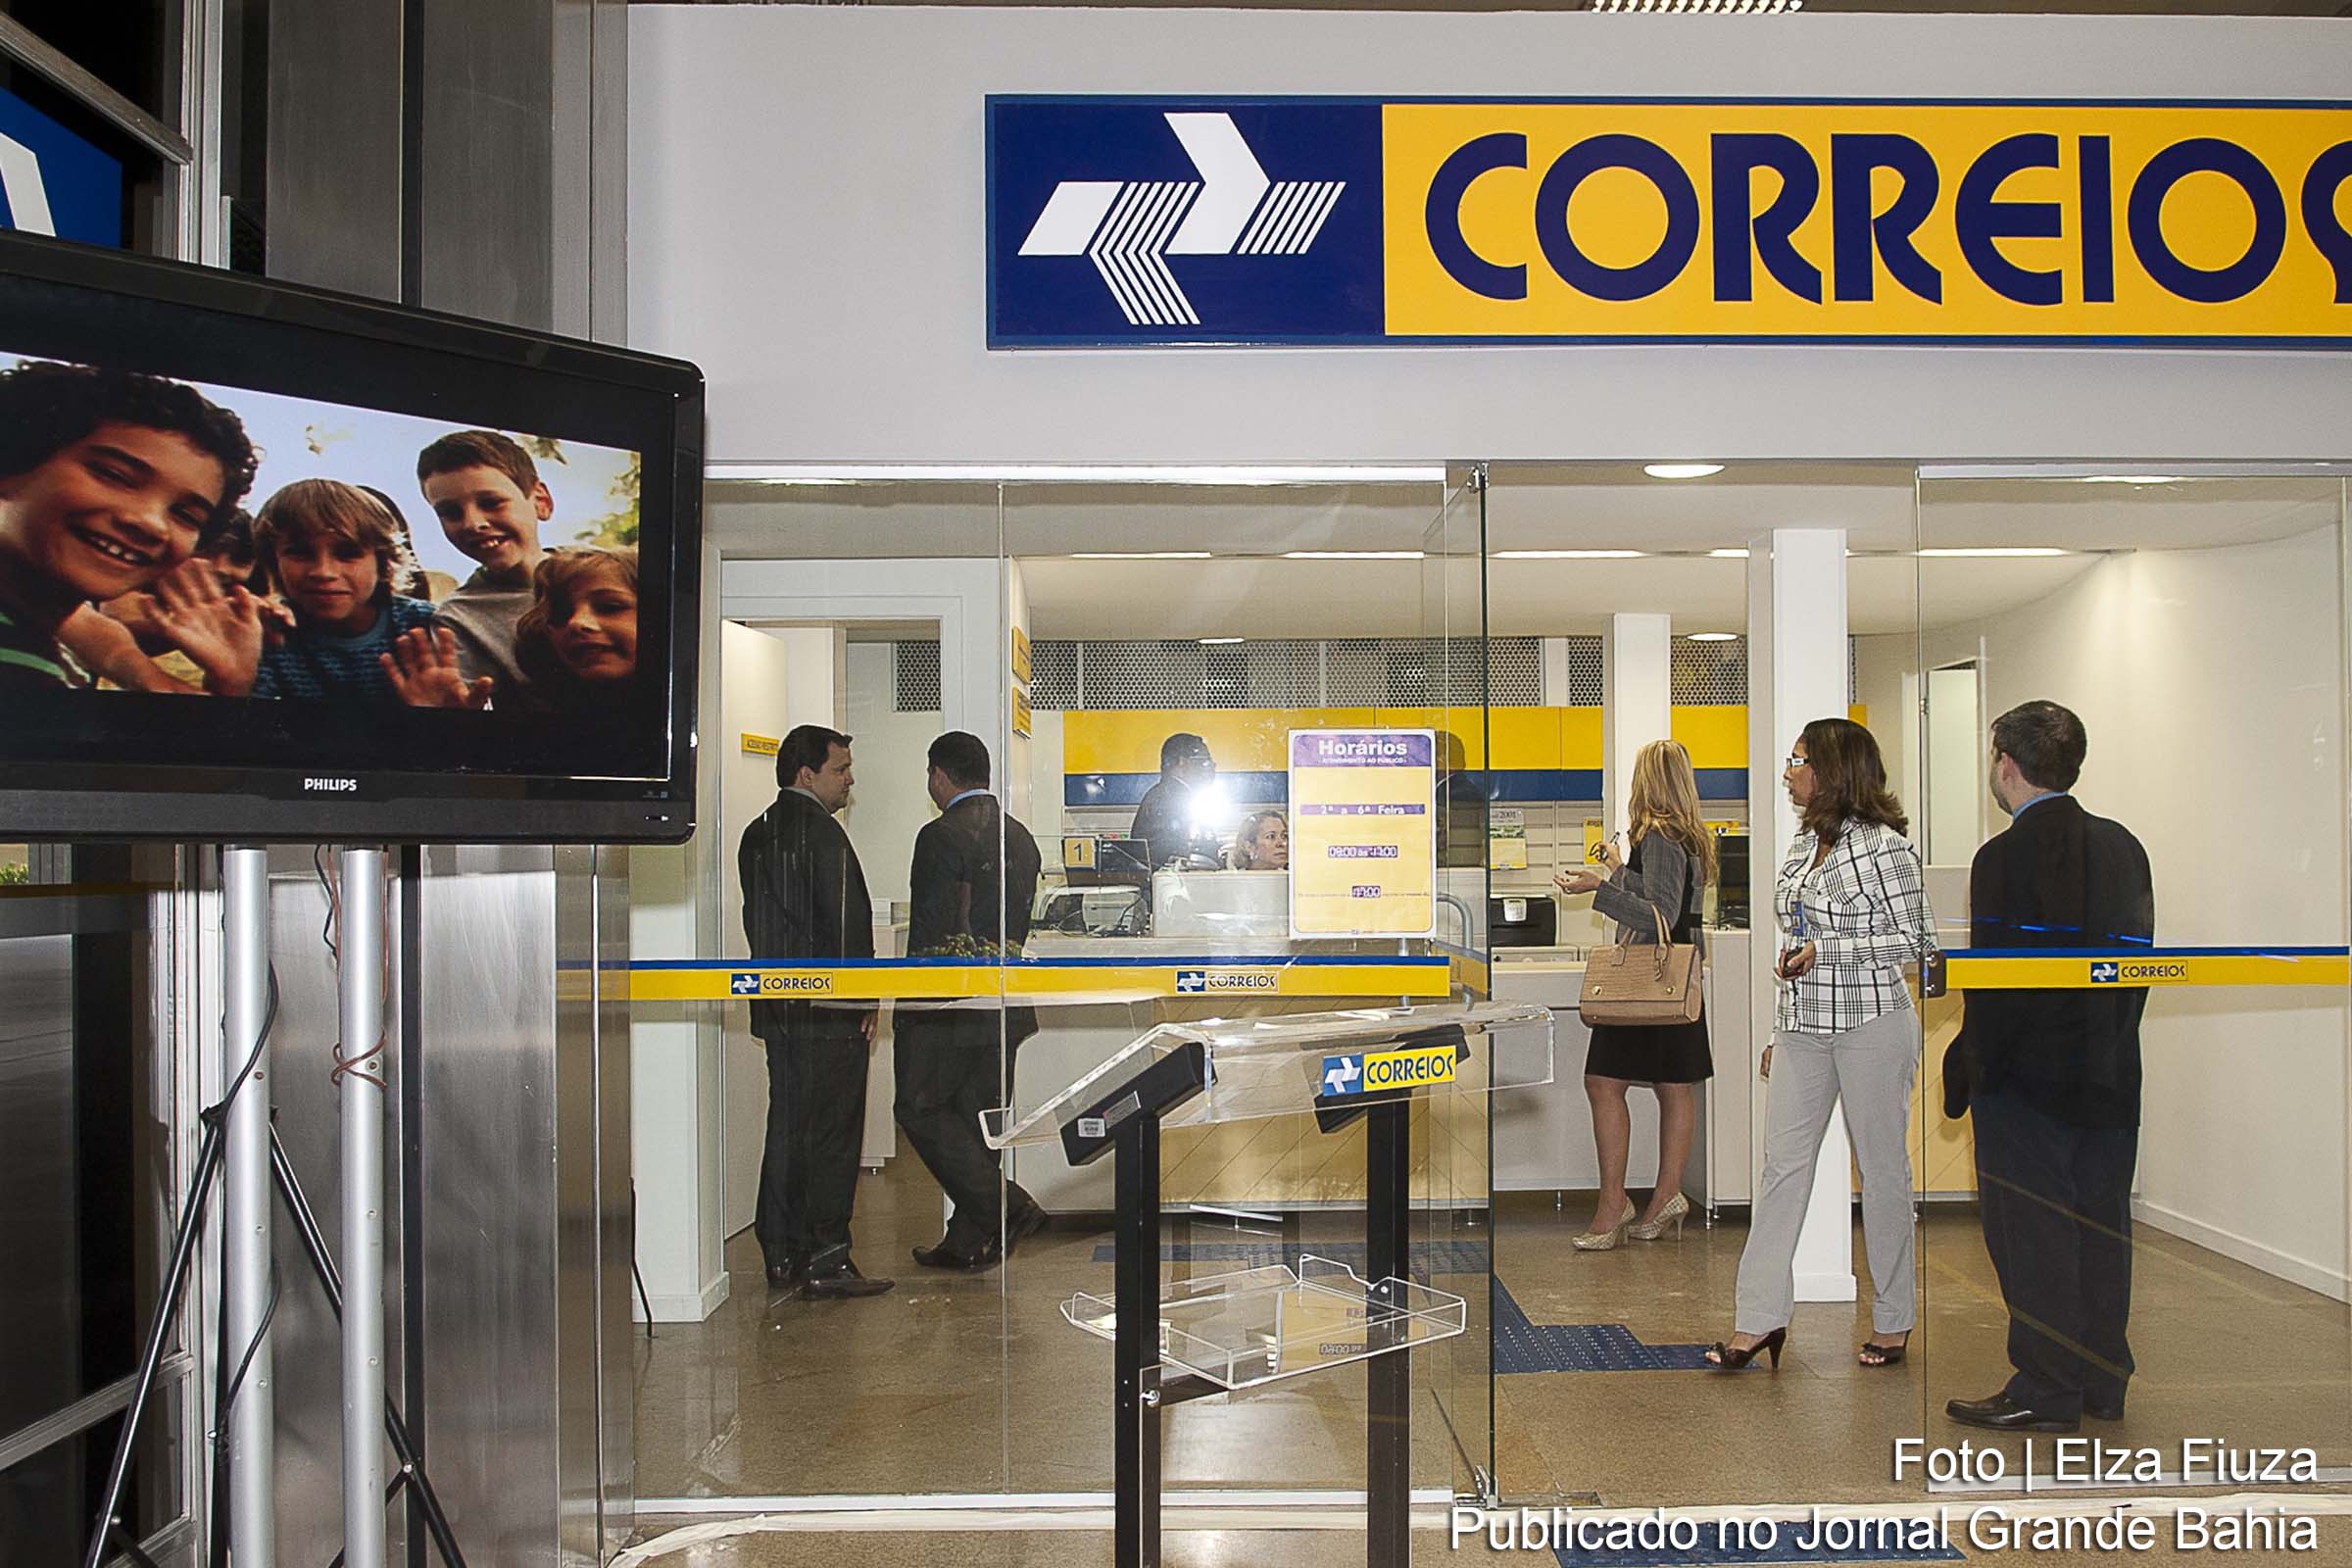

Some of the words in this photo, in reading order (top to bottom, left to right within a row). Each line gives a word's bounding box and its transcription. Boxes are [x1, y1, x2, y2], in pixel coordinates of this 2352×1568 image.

[1426, 131, 2352, 307] CORREIOS
[1318, 739, 1407, 756] Horários
[304, 778, 357, 792] PHILIPS
[1378, 805, 1404, 814] Feira
[1073, 843, 1082, 861] 1
[2121, 965, 2185, 978] CORREIOS
[763, 977, 830, 990] CORREIOS
[1208, 975, 1275, 988] CORREIOS
[1367, 1054, 1453, 1084] CORREIOS
